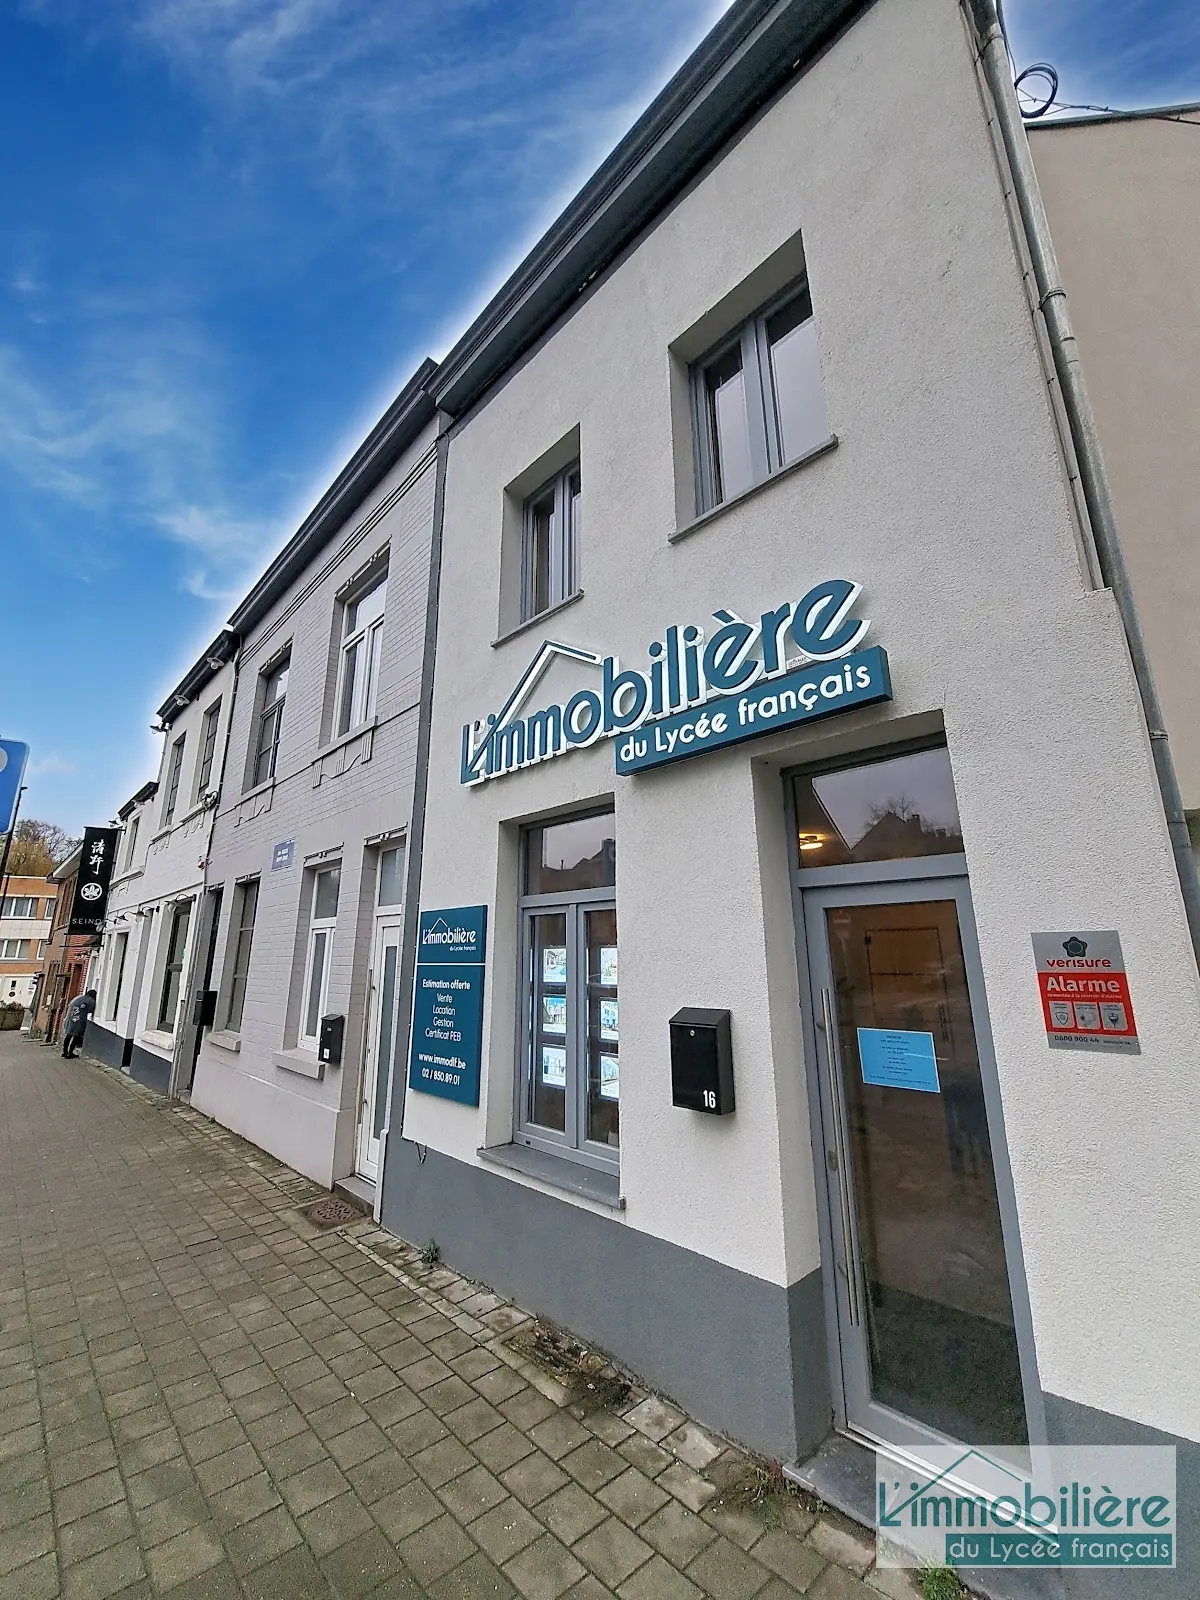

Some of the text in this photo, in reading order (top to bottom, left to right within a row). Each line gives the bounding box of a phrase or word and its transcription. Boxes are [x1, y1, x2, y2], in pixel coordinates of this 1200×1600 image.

[460, 579, 870, 786] L'immobilière
[619, 663, 871, 762] du Lycée français
[422, 926, 477, 945] L'immobilière
[1047, 959, 1112, 968] verisure
[422, 978, 471, 990] Estimation offerte
[1047, 976, 1120, 992] Alarme
[436, 992, 453, 1004] Vente
[432, 1005, 456, 1016] Location
[433, 1016, 454, 1028] Gestion
[425, 1027, 461, 1042] Certificat PEB
[418, 1052, 467, 1070] www.immodlf.be
[421, 1067, 430, 1079] 02
[433, 1070, 460, 1086] 850.89.01
[702, 1089, 716, 1109] 16
